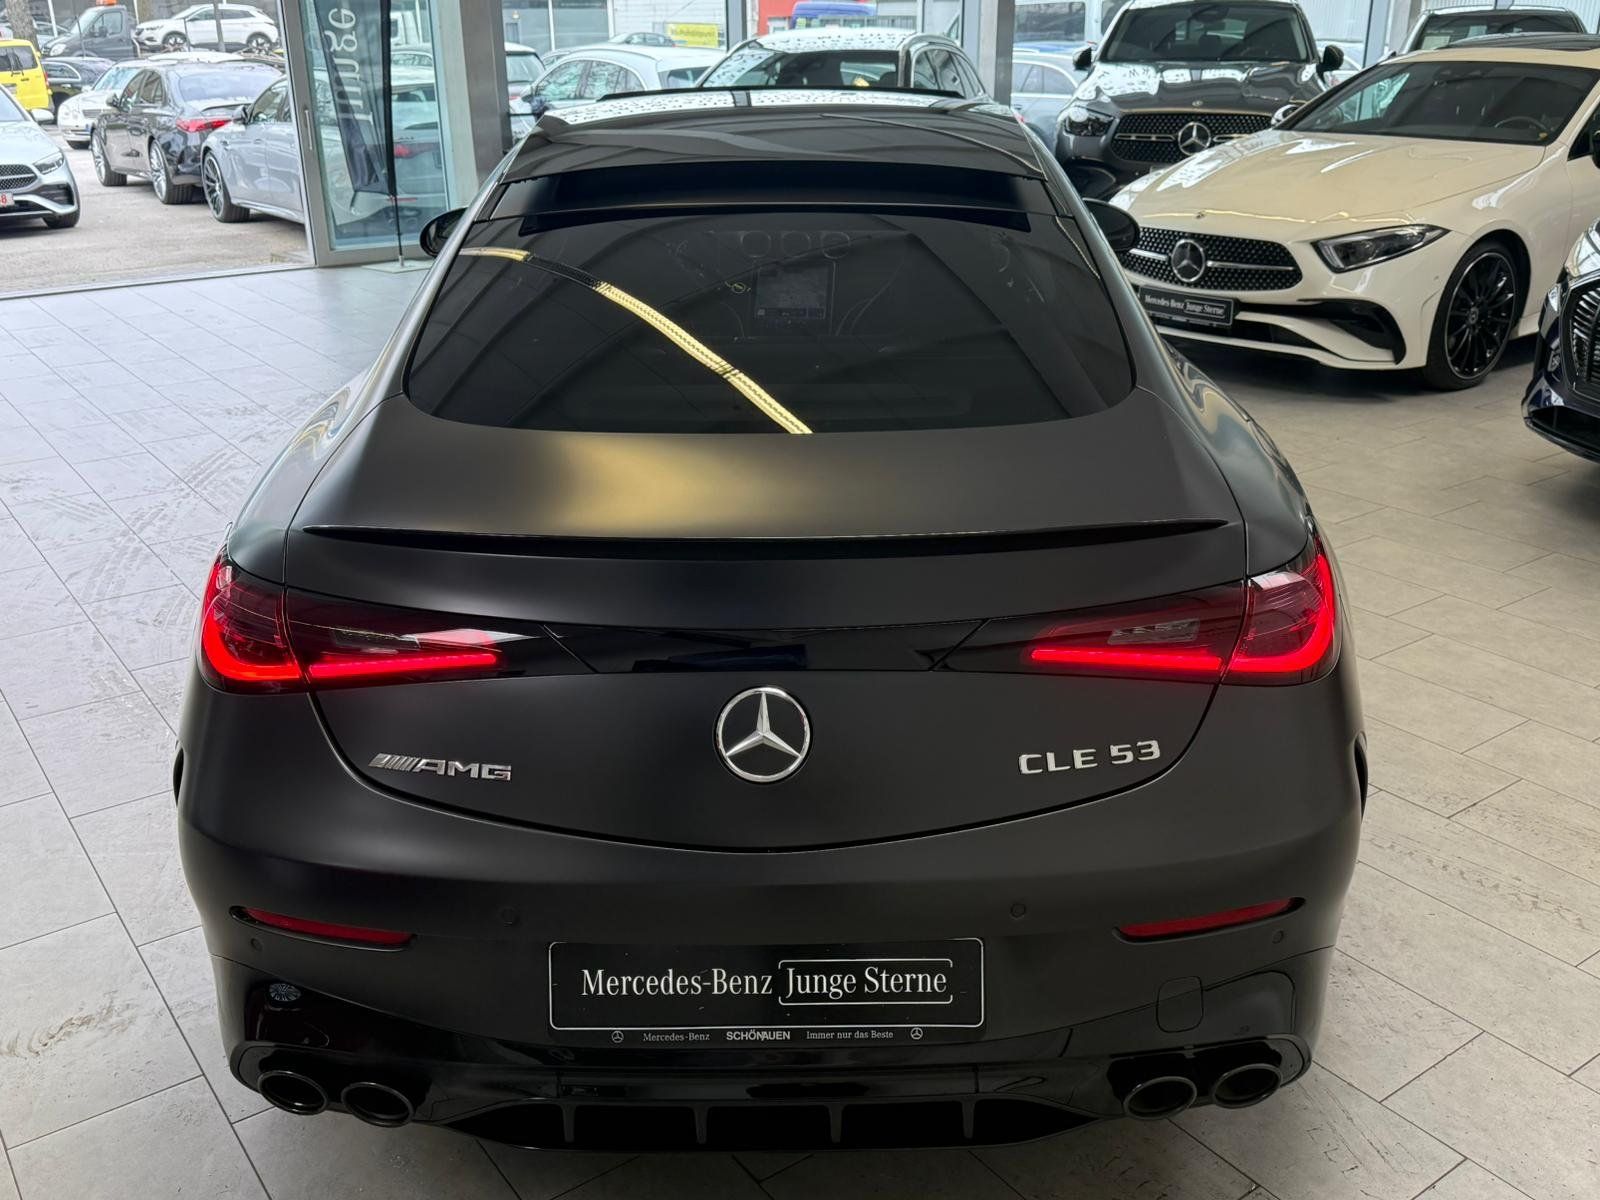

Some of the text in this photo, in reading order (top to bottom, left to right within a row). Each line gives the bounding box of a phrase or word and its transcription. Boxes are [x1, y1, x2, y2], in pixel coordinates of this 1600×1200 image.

[1186, 302, 1224, 315] Junge Sterne
[1018, 739, 1161, 775] CLE 53
[411, 758, 512, 781] AMG
[581, 967, 773, 996] Mercedes-Benz
[785, 966, 947, 1000] Junge Sterne
[643, 1031, 710, 1042] Mercedes-Benz
[726, 1029, 791, 1042] SCHÖNAUEN
[806, 1029, 894, 1040] Immer nur das Beste
